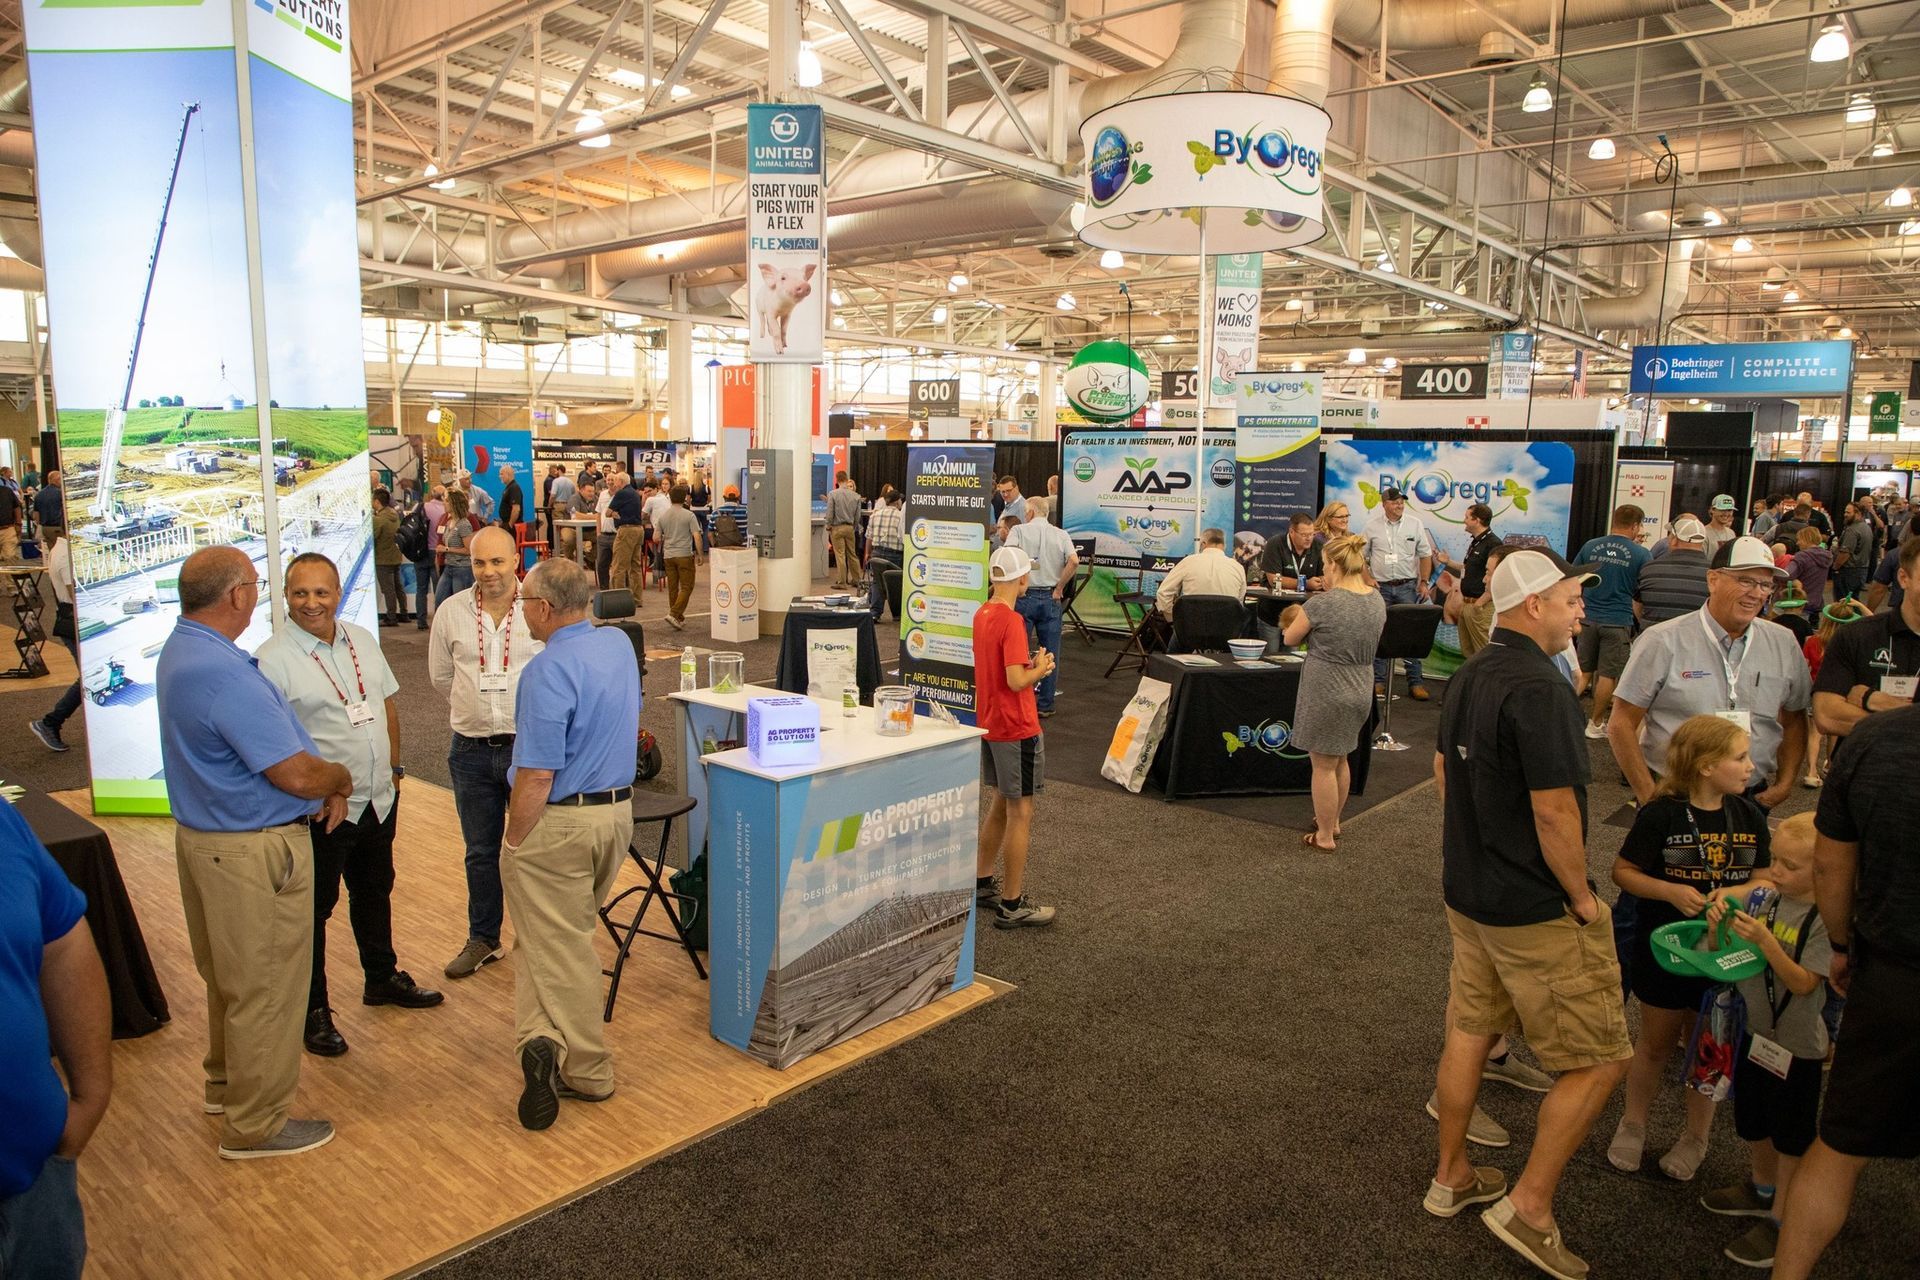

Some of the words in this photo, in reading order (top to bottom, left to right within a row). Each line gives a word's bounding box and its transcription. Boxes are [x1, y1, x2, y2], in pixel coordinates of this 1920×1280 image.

[754, 146, 814, 160] UNITED
[755, 160, 783, 168] ANIMAL
[752, 183, 786, 198] START
[788, 184, 819, 198] YOUR
[756, 200, 782, 214] PIGS
[785, 200, 814, 214] WITH
[767, 215, 775, 230] A
[777, 215, 804, 230] FLEX
[1220, 268, 1257, 279] UNITED
[1217, 296, 1237, 311] WE
[1217, 313, 1253, 328] MOMS
[1671, 357, 1724, 369] Boehringer
[1744, 357, 1821, 368] COMPLETE
[724, 367, 752, 386] PIC
[1416, 367, 1473, 393] 400
[1671, 368, 1718, 380] Ingelheim
[1743, 367, 1838, 378] CONFIDENCE
[916, 382, 950, 401] 600
[1174, 375, 1198, 397] 50
[1243, 417, 1255, 425] PS
[1256, 417, 1313, 426] CONCENTRATE
[1081, 437, 1106, 446] HEALTH
[1108, 437, 1115, 446] IS
[1117, 437, 1127, 446] AN
[1129, 437, 1174, 448] INVESTMENT,
[1177, 435, 1197, 446] NOT
[1213, 439, 1236, 447] EXPEN
[537, 451, 562, 459] PRECISION
[602, 452, 615, 460] INC.
[642, 452, 668, 463] PSI
[922, 459, 977, 476] MAXIMUM
[916, 475, 982, 488] PERFORMANCE.
[1112, 470, 1192, 494] AAP
[911, 494, 936, 506] STARTS
[937, 495, 955, 507] WITH
[956, 496, 969, 507] THE
[970, 496, 986, 509] GUT.
[1097, 493, 1142, 502] ADVANCED
[1144, 494, 1157, 502] AG
[1159, 495, 1208, 505] PRODUCS
[1078, 557, 1115, 566] UNIERSITY
[912, 672, 926, 683] ARE
[926, 674, 940, 686] YOU
[940, 676, 969, 690] GETTING
[921, 686, 973, 705] PERFORMANCE?
[767, 733, 816, 741] SOLUTIONS
[778, 727, 815, 735] PROPERTY
[861, 809, 883, 828] AG
[886, 786, 965, 821] PROPERTY
[861, 803, 964, 846] SOLUTIONS
[803, 883, 838, 902] DESIGN
[859, 864, 897, 883] TURNKEY
[900, 843, 961, 870] CONSTRUCTION
[881, 865, 929, 888] EQUIPMENT
